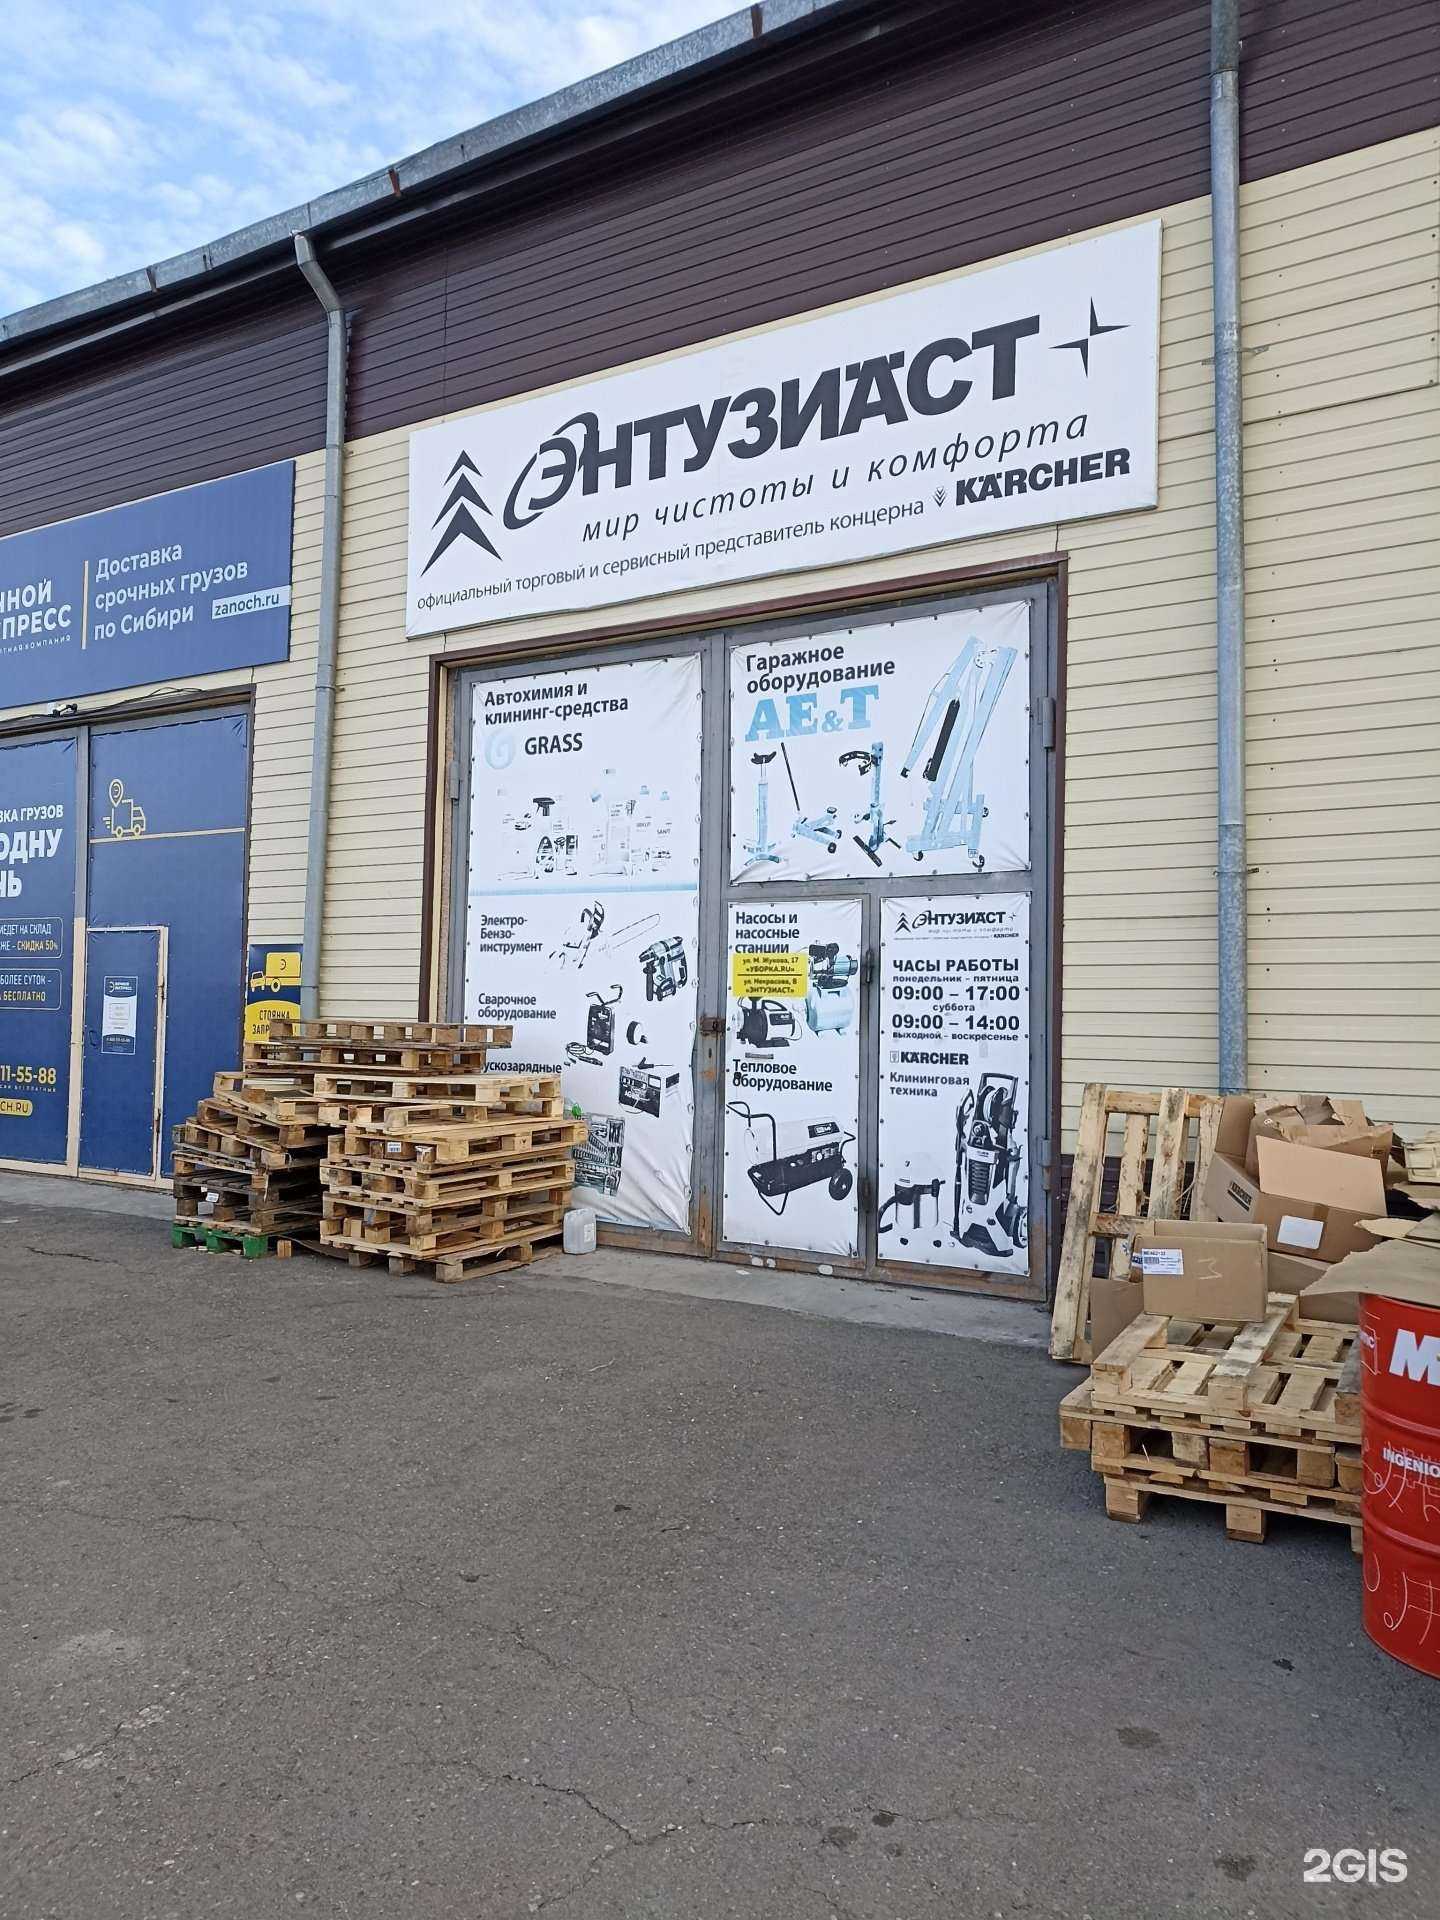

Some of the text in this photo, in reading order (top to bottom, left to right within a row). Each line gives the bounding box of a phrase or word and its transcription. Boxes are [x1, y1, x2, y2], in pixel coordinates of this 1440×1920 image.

[582, 413, 1089, 543] мир чистоты и комфорта
[417, 499, 925, 611] официальный торговый и сервисный представитель концерна
[95, 543, 183, 583] Доставка
[95, 560, 249, 613] срочных грузов
[213, 590, 280, 618] zanoch.ru
[0, 604, 72, 640] ПРЕСС
[94, 604, 194, 641] по Сибири
[746, 645, 845, 673] Гаражное
[747, 657, 896, 694] оборудование
[484, 682, 588, 708] Автохимия и
[484, 697, 629, 726] клининг-средства
[745, 684, 880, 743] AE&T
[524, 732, 583, 756] GRASS
[0, 804, 65, 823] КА ГРУЗОВ
[0, 828, 63, 865] ОДНУ
[480, 914, 528, 929] Электро-
[735, 911, 798, 925] Насосы и
[29, 923, 53, 935] СКЛАД
[480, 927, 515, 941] Бензо-
[735, 928, 800, 940] насосные
[17, 940, 44, 952] СКИДКА
[479, 941, 543, 955] инструмент
[734, 943, 790, 954] станции
[892, 958, 1019, 972] ЧАСЫ РАБОТЫ
[23, 974, 46, 985] СУТОК
[892, 975, 962, 983] понедельник
[973, 975, 1019, 983] пятница
[3, 990, 46, 1002] БЕСПЛАТНО
[478, 992, 537, 1007] Сварочное
[892, 985, 944, 1001] 09:00
[965, 985, 1020, 1001] 17:00
[478, 1006, 557, 1021] оборудование
[932, 1002, 976, 1013] суббота
[892, 1013, 944, 1029] 09:00
[965, 1014, 1020, 1031] 14:00
[892, 1031, 943, 1040] выходной
[951, 1033, 1019, 1042] воскресенье
[484, 1061, 562, 1074] ускозарядные
[733, 1059, 797, 1075] Тепловое
[732, 1073, 833, 1092] оборудование
[889, 1071, 970, 1086] Клининговая
[889, 1086, 938, 1097] техника
